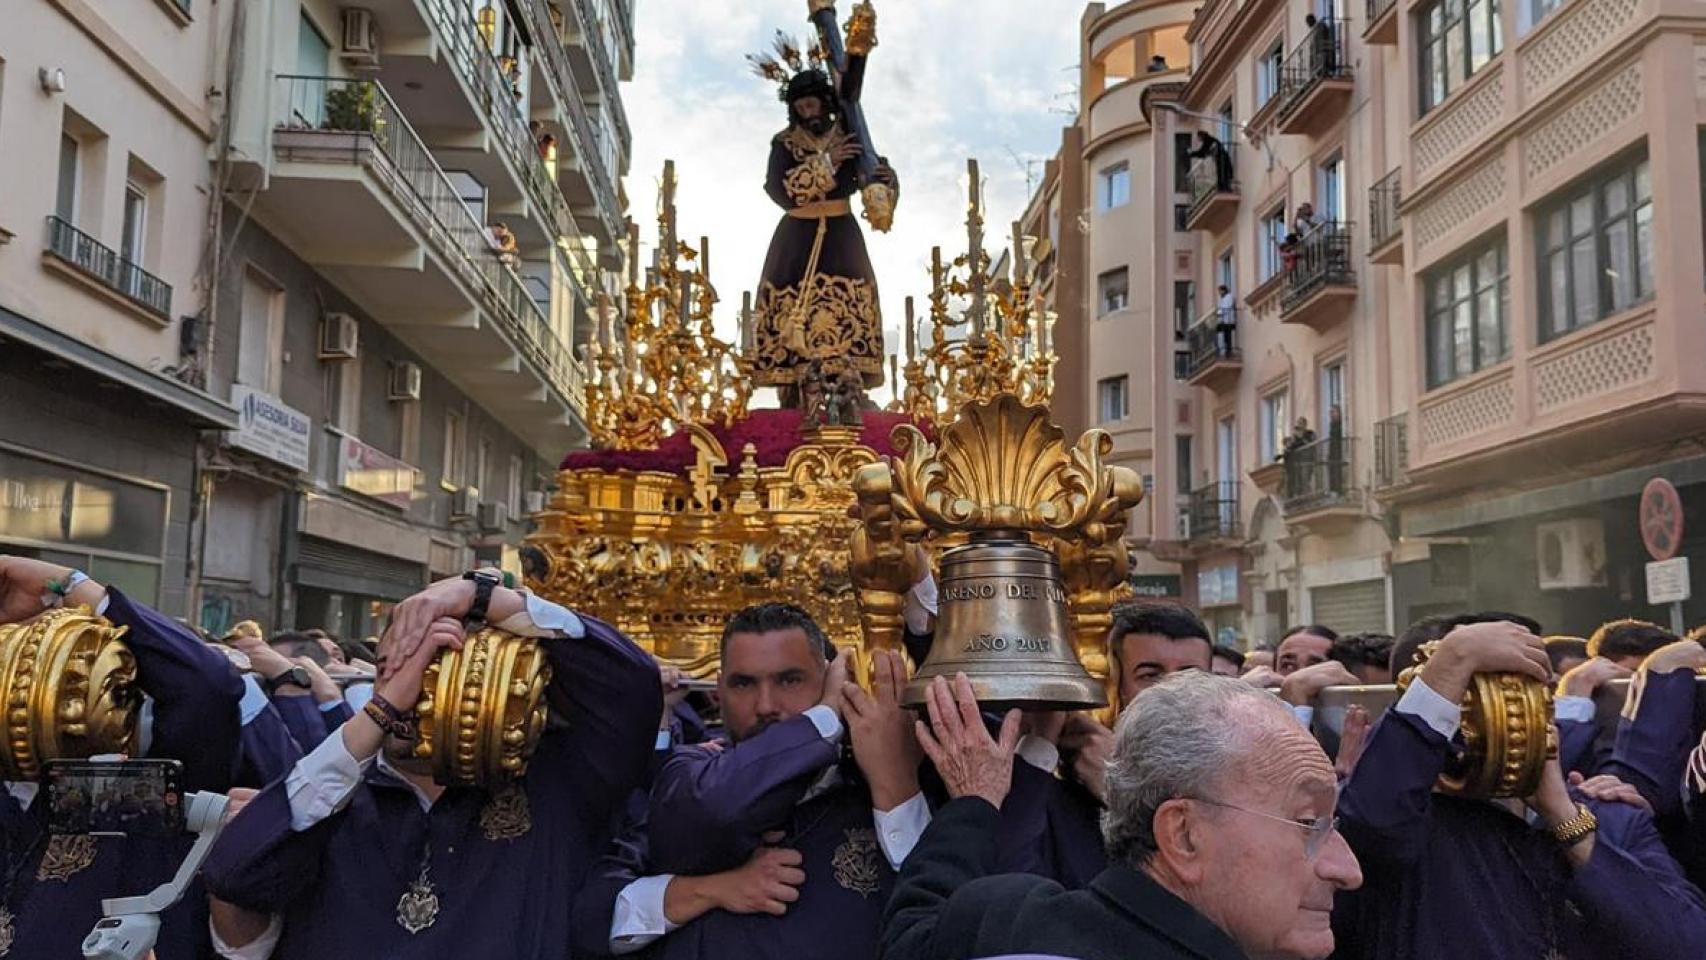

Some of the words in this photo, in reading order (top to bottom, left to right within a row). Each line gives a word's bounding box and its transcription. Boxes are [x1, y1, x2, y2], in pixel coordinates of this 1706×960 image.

[941, 583, 995, 603] ARENO
[1007, 583, 1037, 600] DEL
[963, 635, 1006, 652] AÑO
